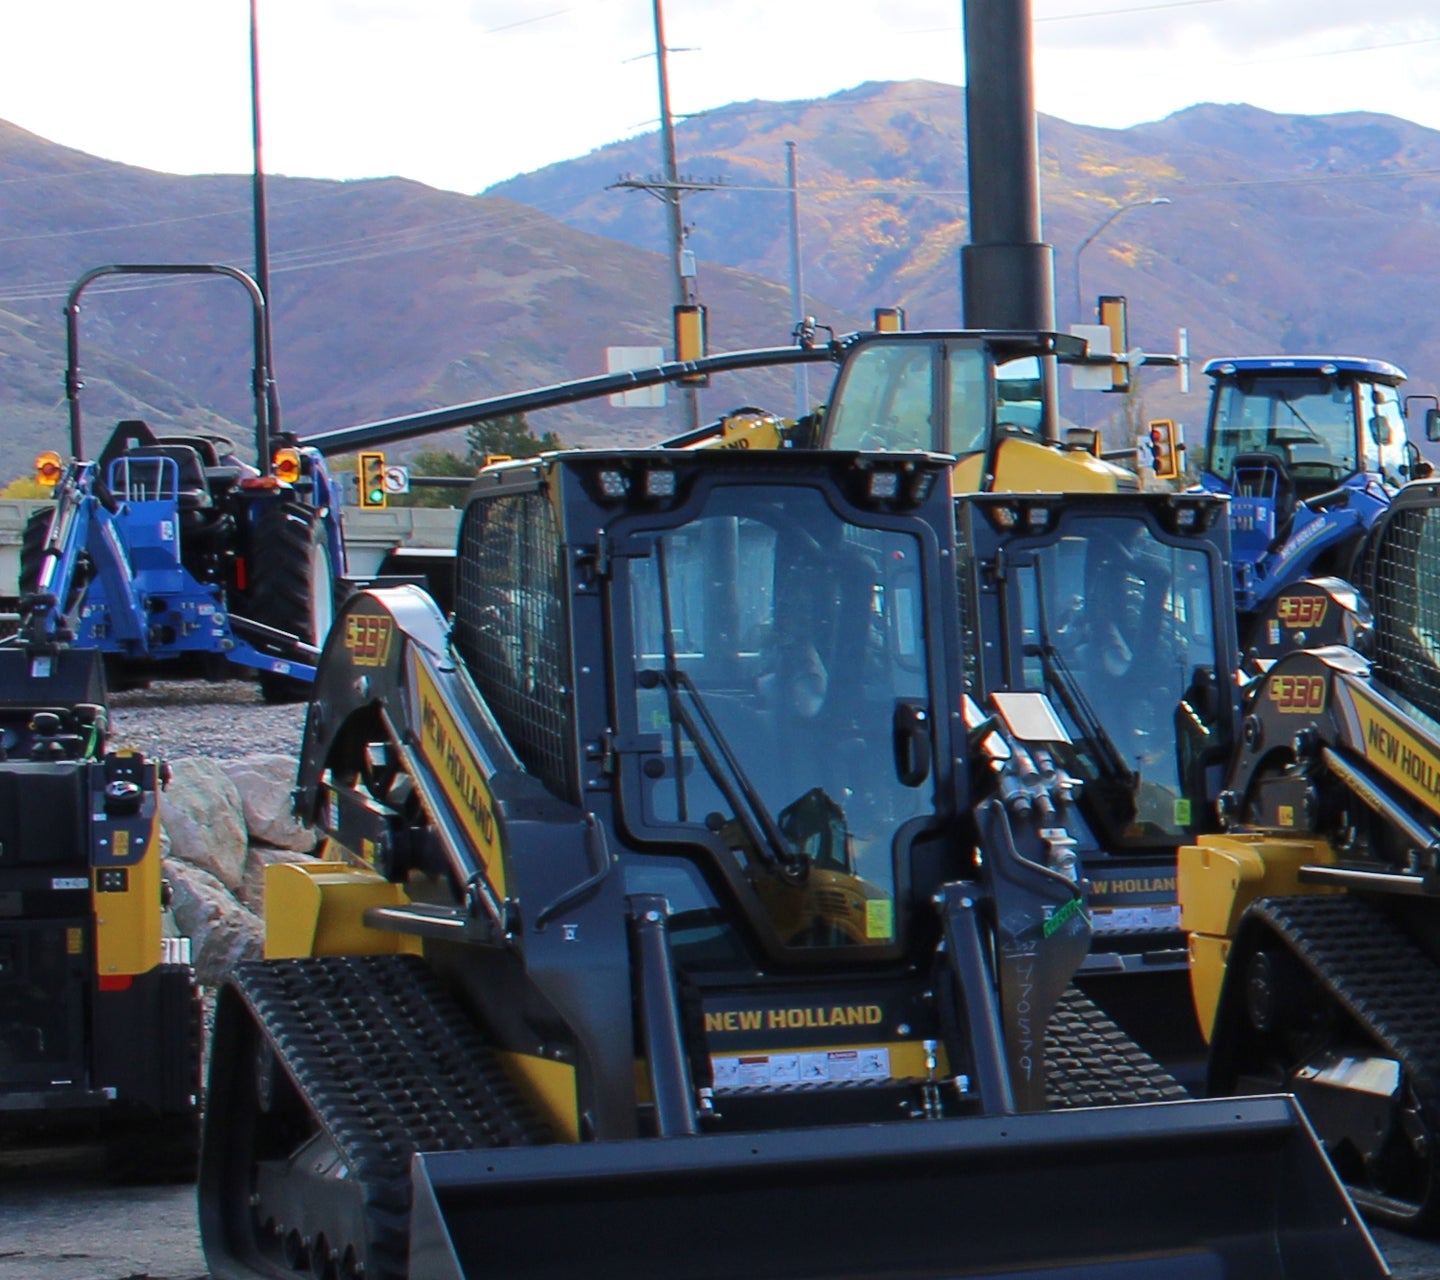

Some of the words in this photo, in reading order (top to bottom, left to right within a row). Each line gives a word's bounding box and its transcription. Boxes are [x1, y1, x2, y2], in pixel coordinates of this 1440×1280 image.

[1368, 719, 1399, 766] NEW
[423, 695, 446, 758] NEW
[447, 738, 493, 846] HOLLAND
[1112, 877, 1176, 893] HOLLAN
[705, 1011, 762, 1032] NEW
[767, 1005, 882, 1028] HOLLAND
